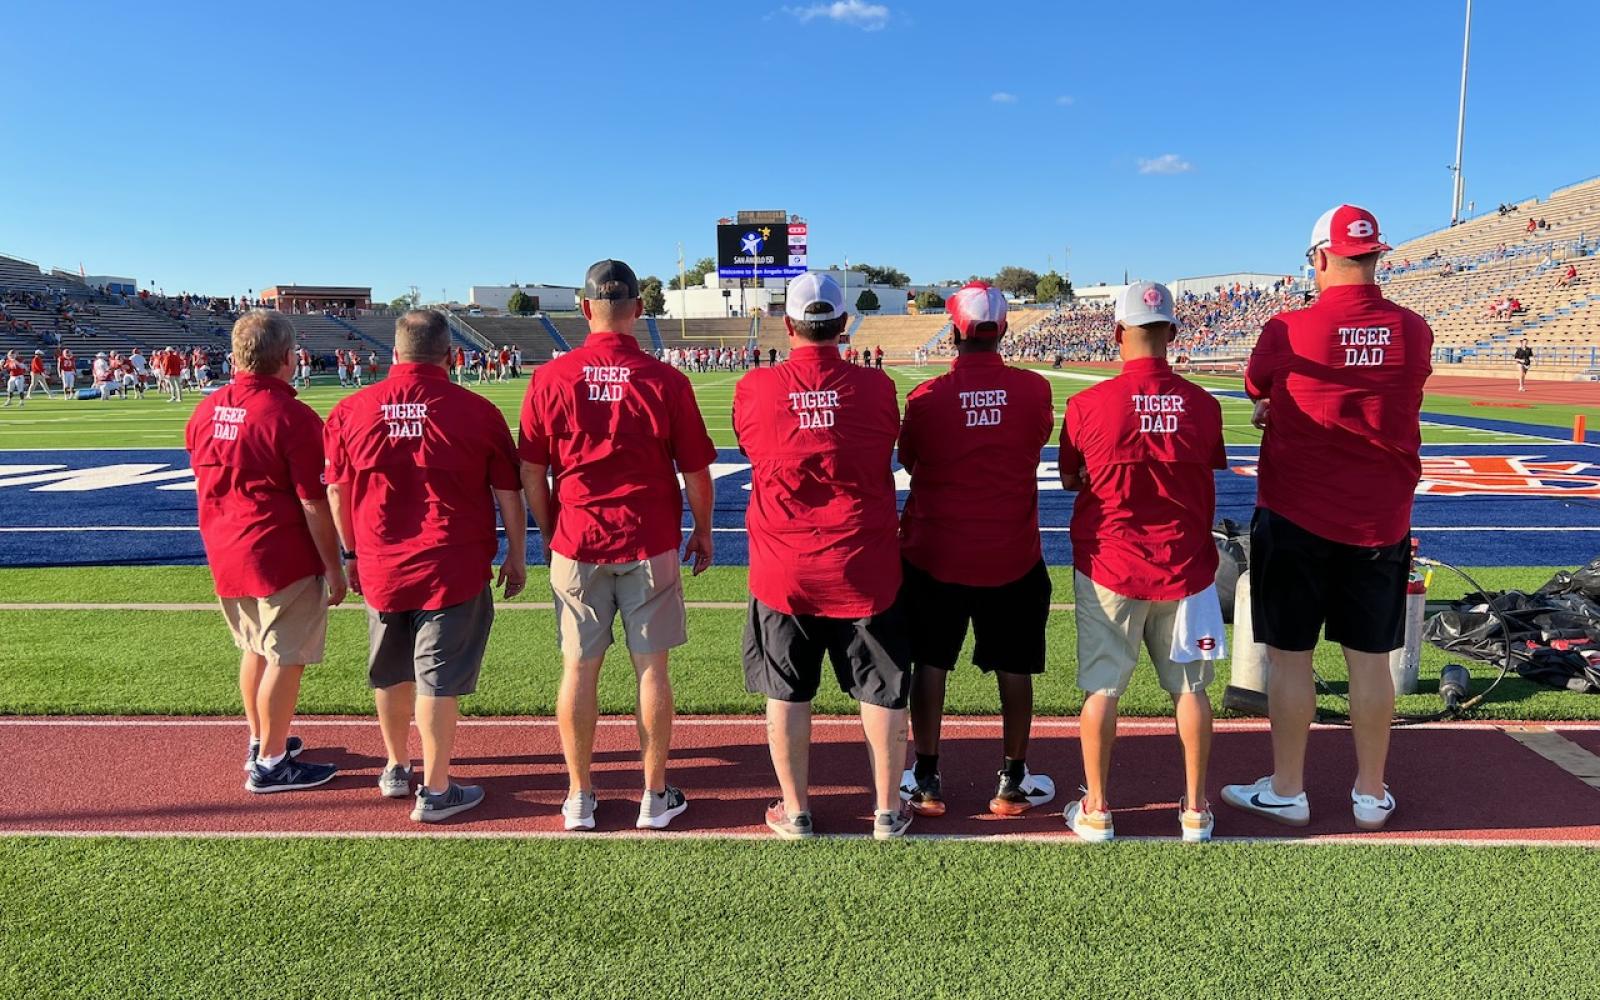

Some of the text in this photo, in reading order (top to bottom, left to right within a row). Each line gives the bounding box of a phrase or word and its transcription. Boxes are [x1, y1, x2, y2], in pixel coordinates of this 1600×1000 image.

[1347, 220, 1374, 237] B
[764, 268, 782, 277] Angelo
[783, 268, 806, 276] Stadium
[1338, 327, 1391, 345] TIGER
[1345, 348, 1384, 367] DAD
[583, 366, 630, 383] TIGER
[588, 383, 623, 402] DAD
[789, 390, 840, 410] TIGER
[959, 389, 1008, 409] TIGER
[380, 403, 428, 420] TIGER
[1132, 395, 1185, 412] TIGER
[212, 405, 247, 424] TIGER
[799, 409, 835, 429] DAD
[965, 408, 1001, 427] DAD
[213, 423, 239, 441] DAD
[388, 420, 422, 437] DAD
[1139, 414, 1178, 434] DAD
